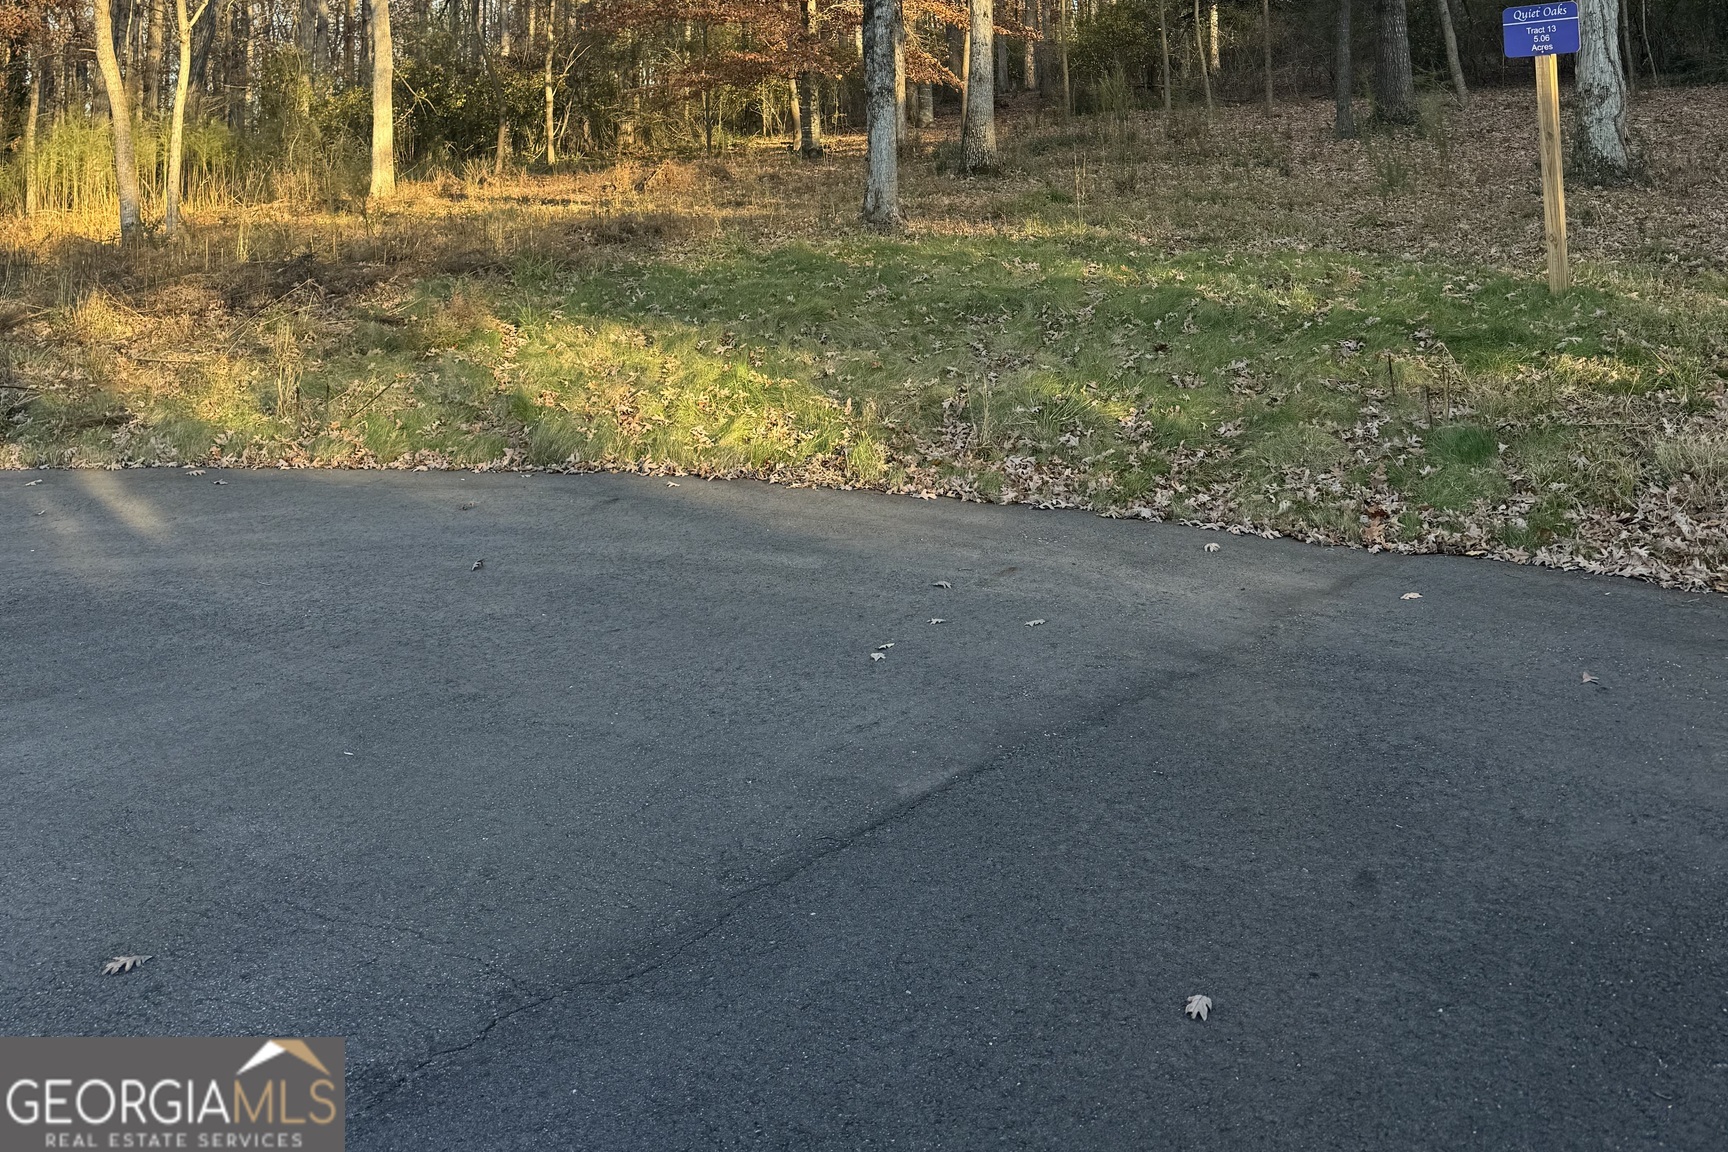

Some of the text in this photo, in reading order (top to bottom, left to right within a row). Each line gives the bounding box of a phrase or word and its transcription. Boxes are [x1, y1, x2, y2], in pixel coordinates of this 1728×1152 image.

[1513, 4, 1567, 21] Quiet Oaks
[1526, 25, 1557, 35] Tract 13
[1531, 43, 1554, 52] Acres
